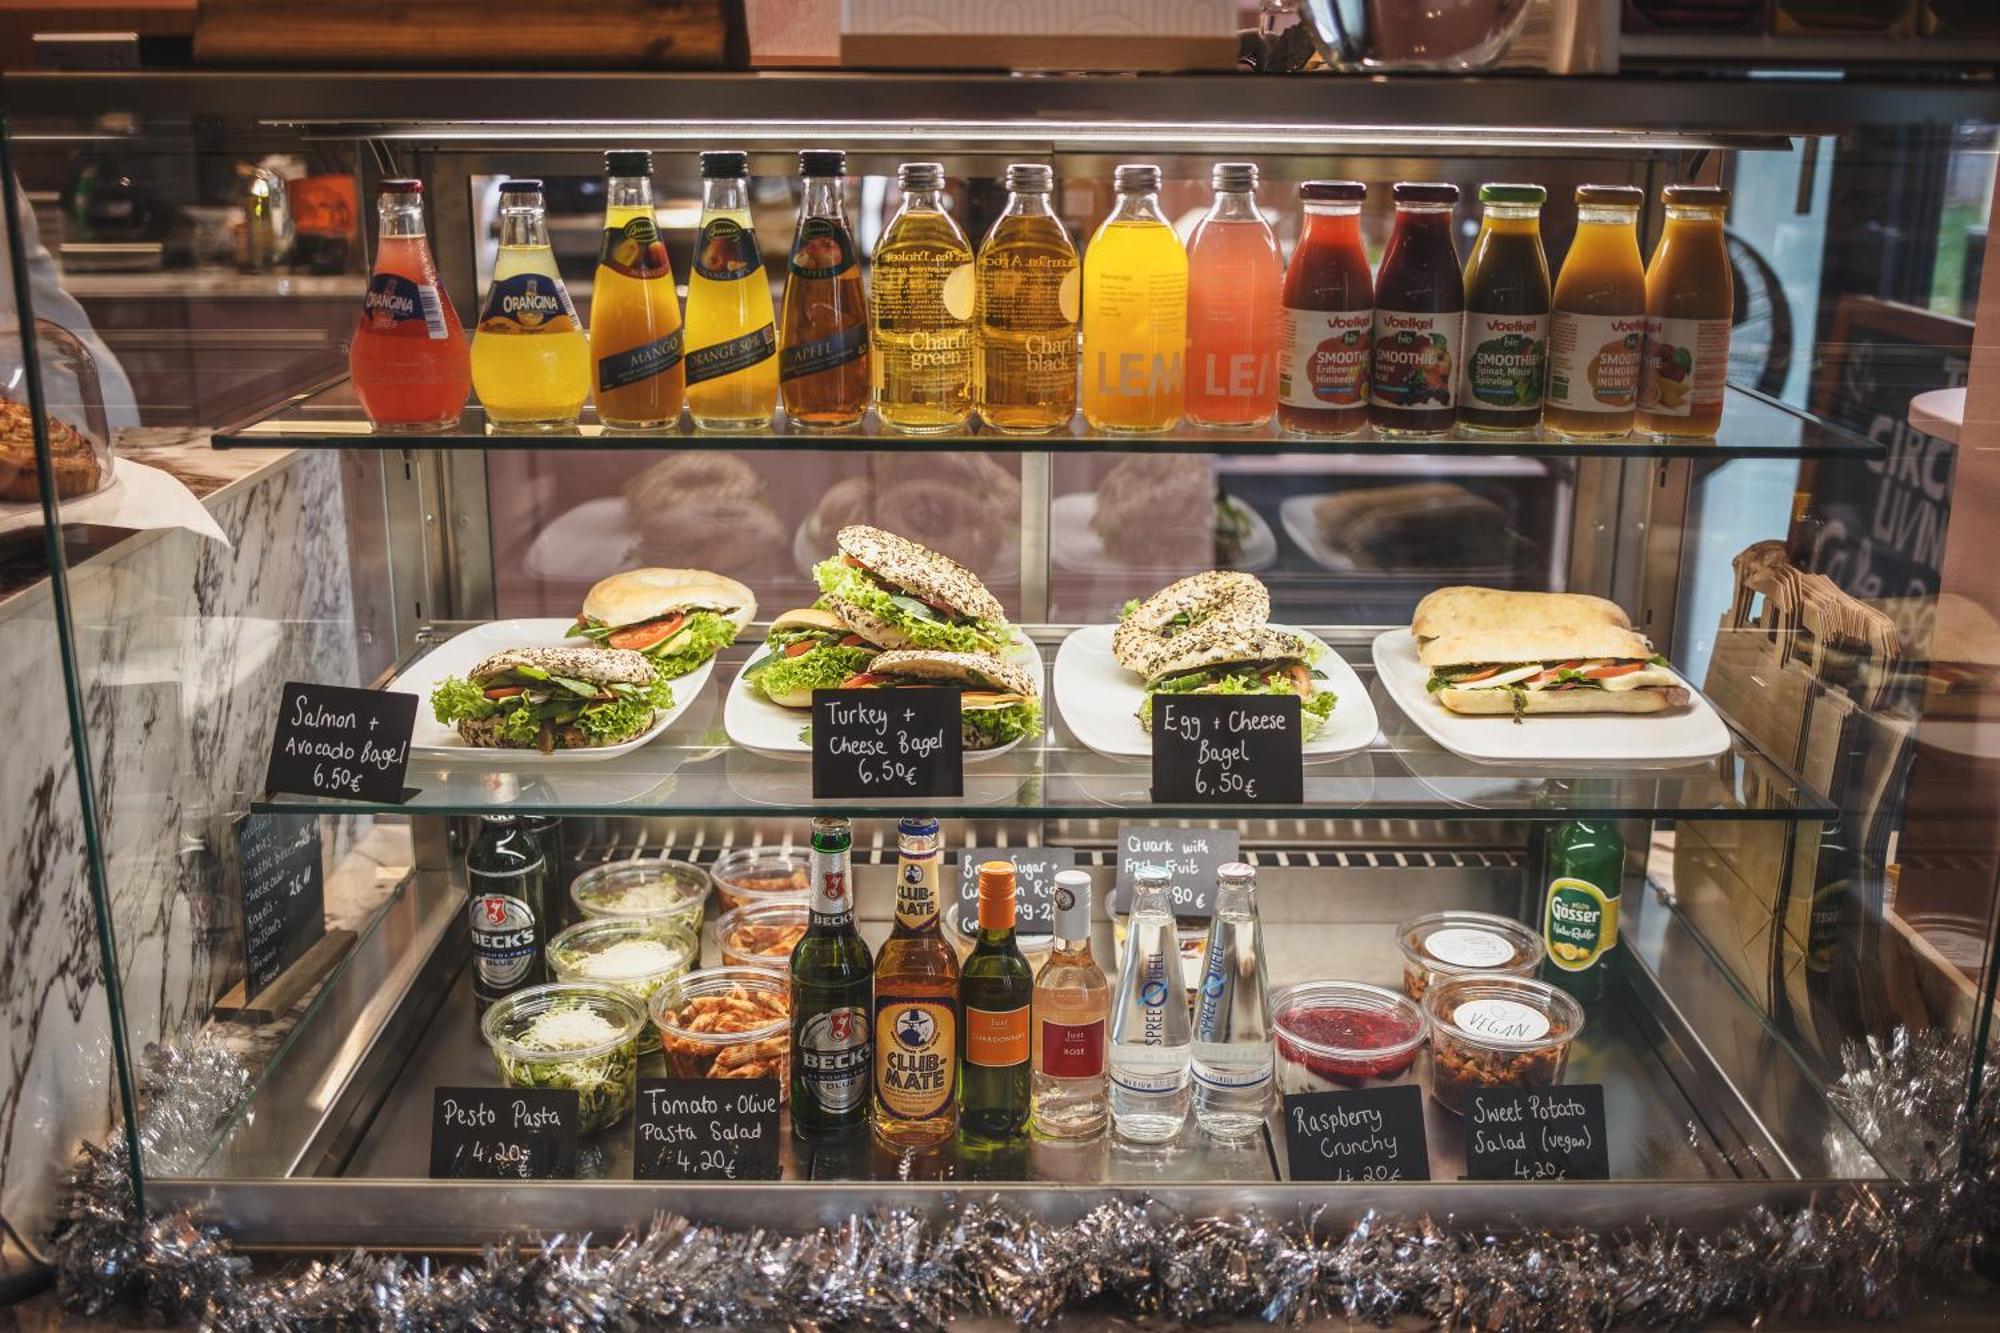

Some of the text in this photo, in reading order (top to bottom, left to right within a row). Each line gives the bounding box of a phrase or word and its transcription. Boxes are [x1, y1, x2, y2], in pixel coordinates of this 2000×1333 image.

[366, 291, 413, 313] ORANGINA
[503, 295, 558, 312] ORANGINA
[1383, 315, 1434, 330] Voelkel
[1486, 319, 1537, 333] Voelkel
[630, 336, 678, 367] MANGO
[911, 351, 961, 370] green
[1027, 352, 1069, 372] black
[1476, 353, 1537, 366] SMOOTHIE
[291, 694, 380, 731] Salmon +
[825, 701, 916, 736] Turkey +
[1164, 704, 1287, 741] Egg + Cheese
[285, 736, 407, 770] Avocado Bagel
[829, 728, 944, 758] Cheese Bagel
[1197, 738, 1250, 770] Bagel
[1127, 835, 1210, 855] Quark with
[1011, 855, 1047, 880] Sugar
[1165, 858, 1200, 875] Fruit
[1551, 896, 1600, 923] Gösser
[1469, 1012, 1530, 1037] VEGAN
[887, 1051, 947, 1072] CLUB-
[885, 1068, 945, 1090] MATE
[443, 1099, 561, 1128] Pesto Pasta
[643, 1088, 777, 1116] Tomato + Olive
[1474, 1095, 1586, 1124] Sweet Potato
[640, 1120, 762, 1143] Pasta Salad
[1292, 1105, 1382, 1136] Raspberry
[1320, 1134, 1398, 1159] Crunchy
[1475, 1124, 1592, 1154] Salad (vegan)
